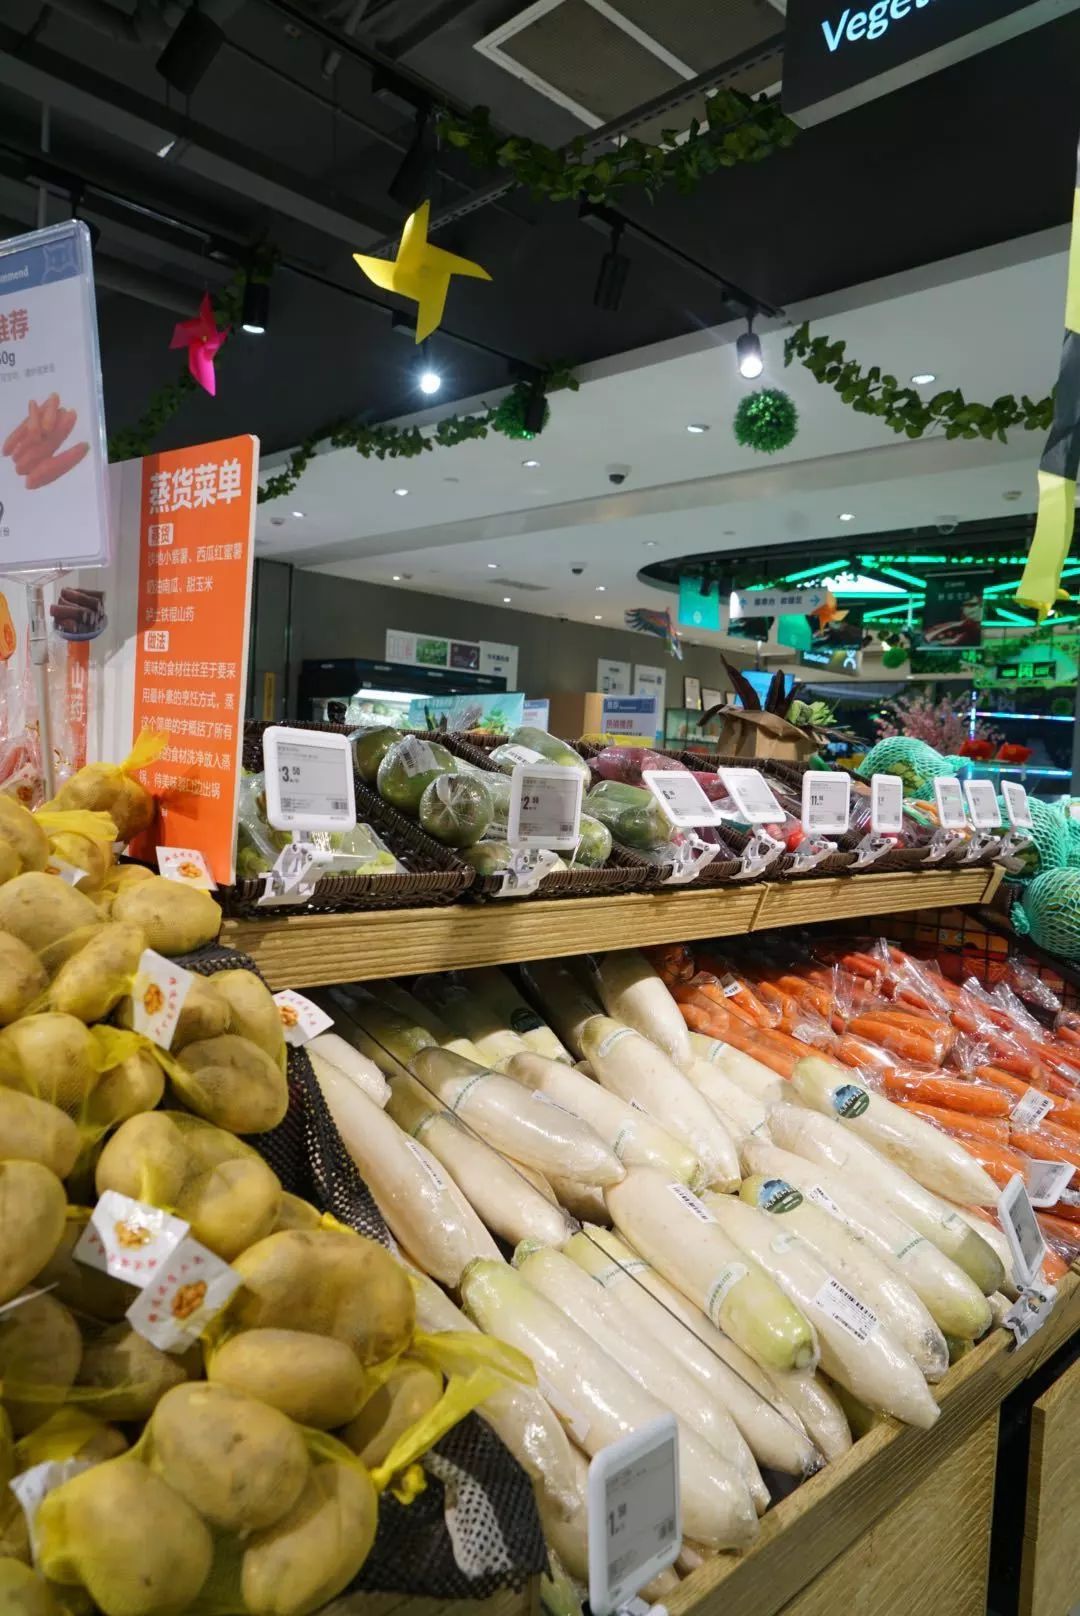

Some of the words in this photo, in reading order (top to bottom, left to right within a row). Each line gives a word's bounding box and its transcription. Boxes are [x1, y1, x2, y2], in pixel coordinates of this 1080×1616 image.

[821, 0, 934, 52] Vege
[149, 457, 242, 515] 蒸货菜单
